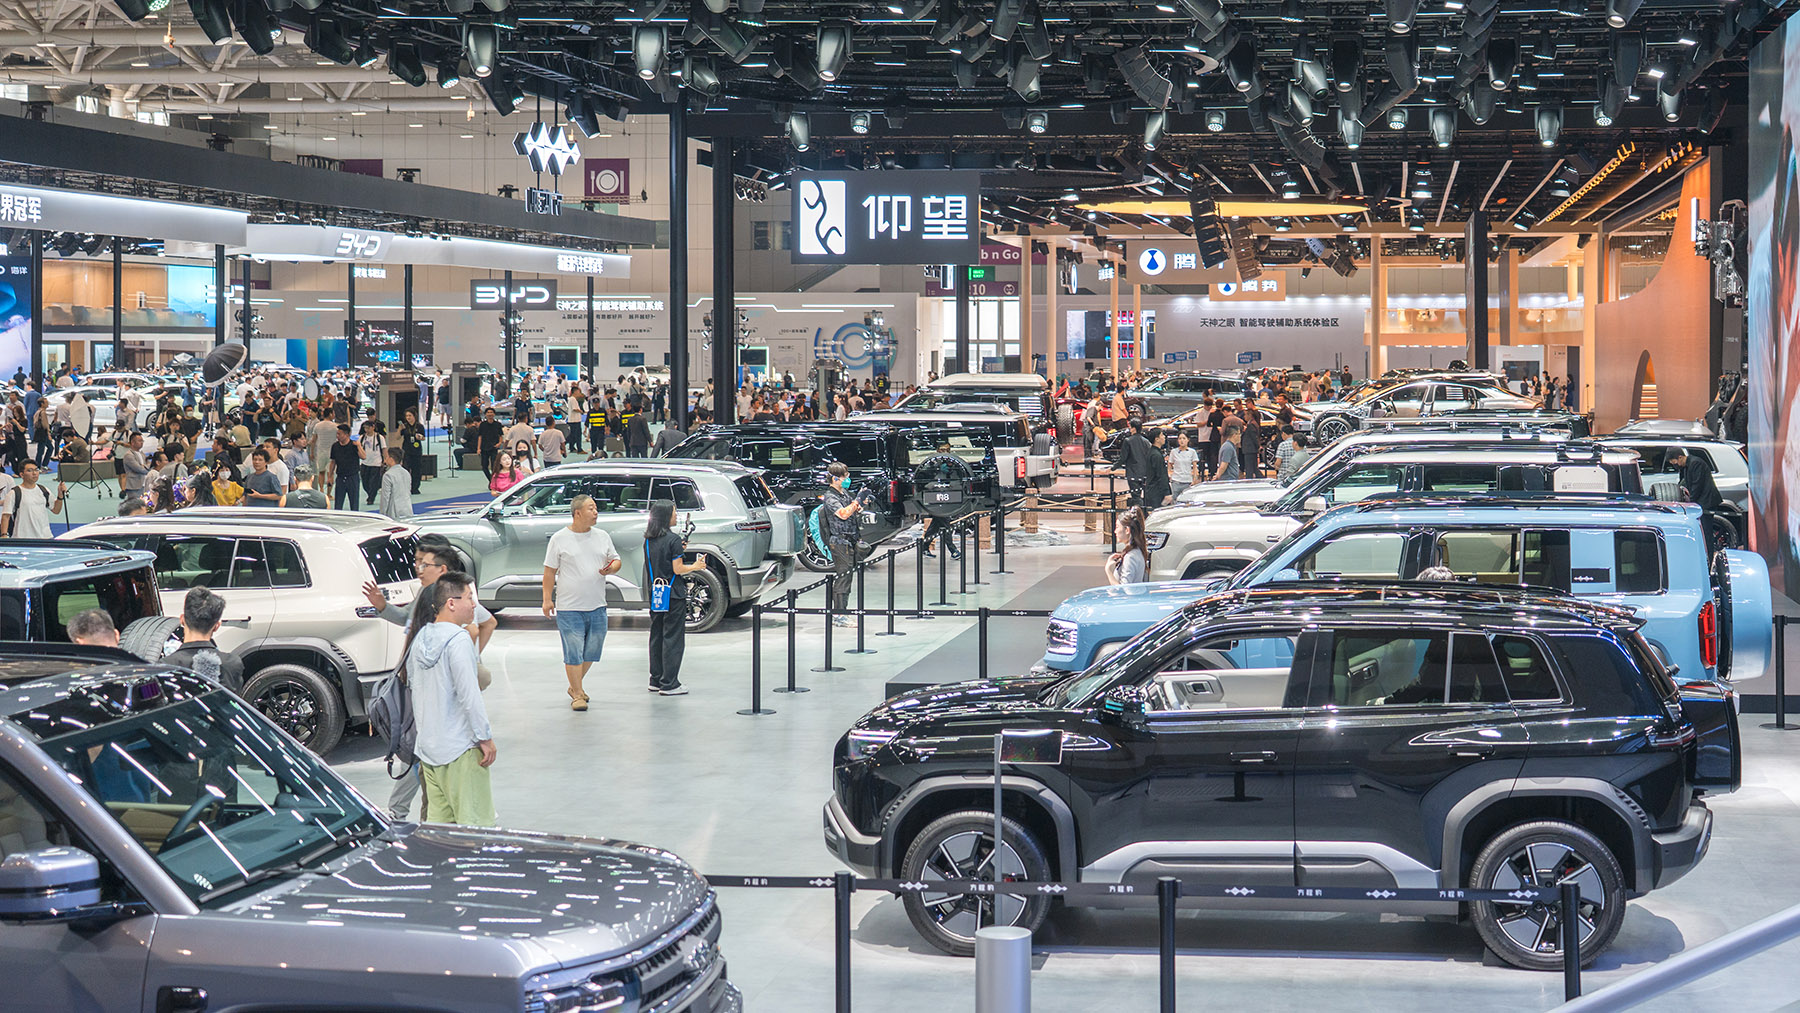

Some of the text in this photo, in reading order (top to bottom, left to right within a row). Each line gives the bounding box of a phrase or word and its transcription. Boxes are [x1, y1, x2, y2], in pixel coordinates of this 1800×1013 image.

[0, 193, 42, 223] 界冠军
[862, 195, 969, 240] 仰望
[336, 232, 382, 256] BYD
[1002, 249, 1020, 260] Go
[475, 286, 550, 303] BYD
[972, 284, 986, 295] 10
[1200, 318, 1340, 328] 天神之眼 智能驾驶辅助系统体验区
[1108, 885, 1134, 894] 方程豹
[1296, 888, 1323, 897] 方程豹
[1438, 890, 1465, 898] 方程豹
